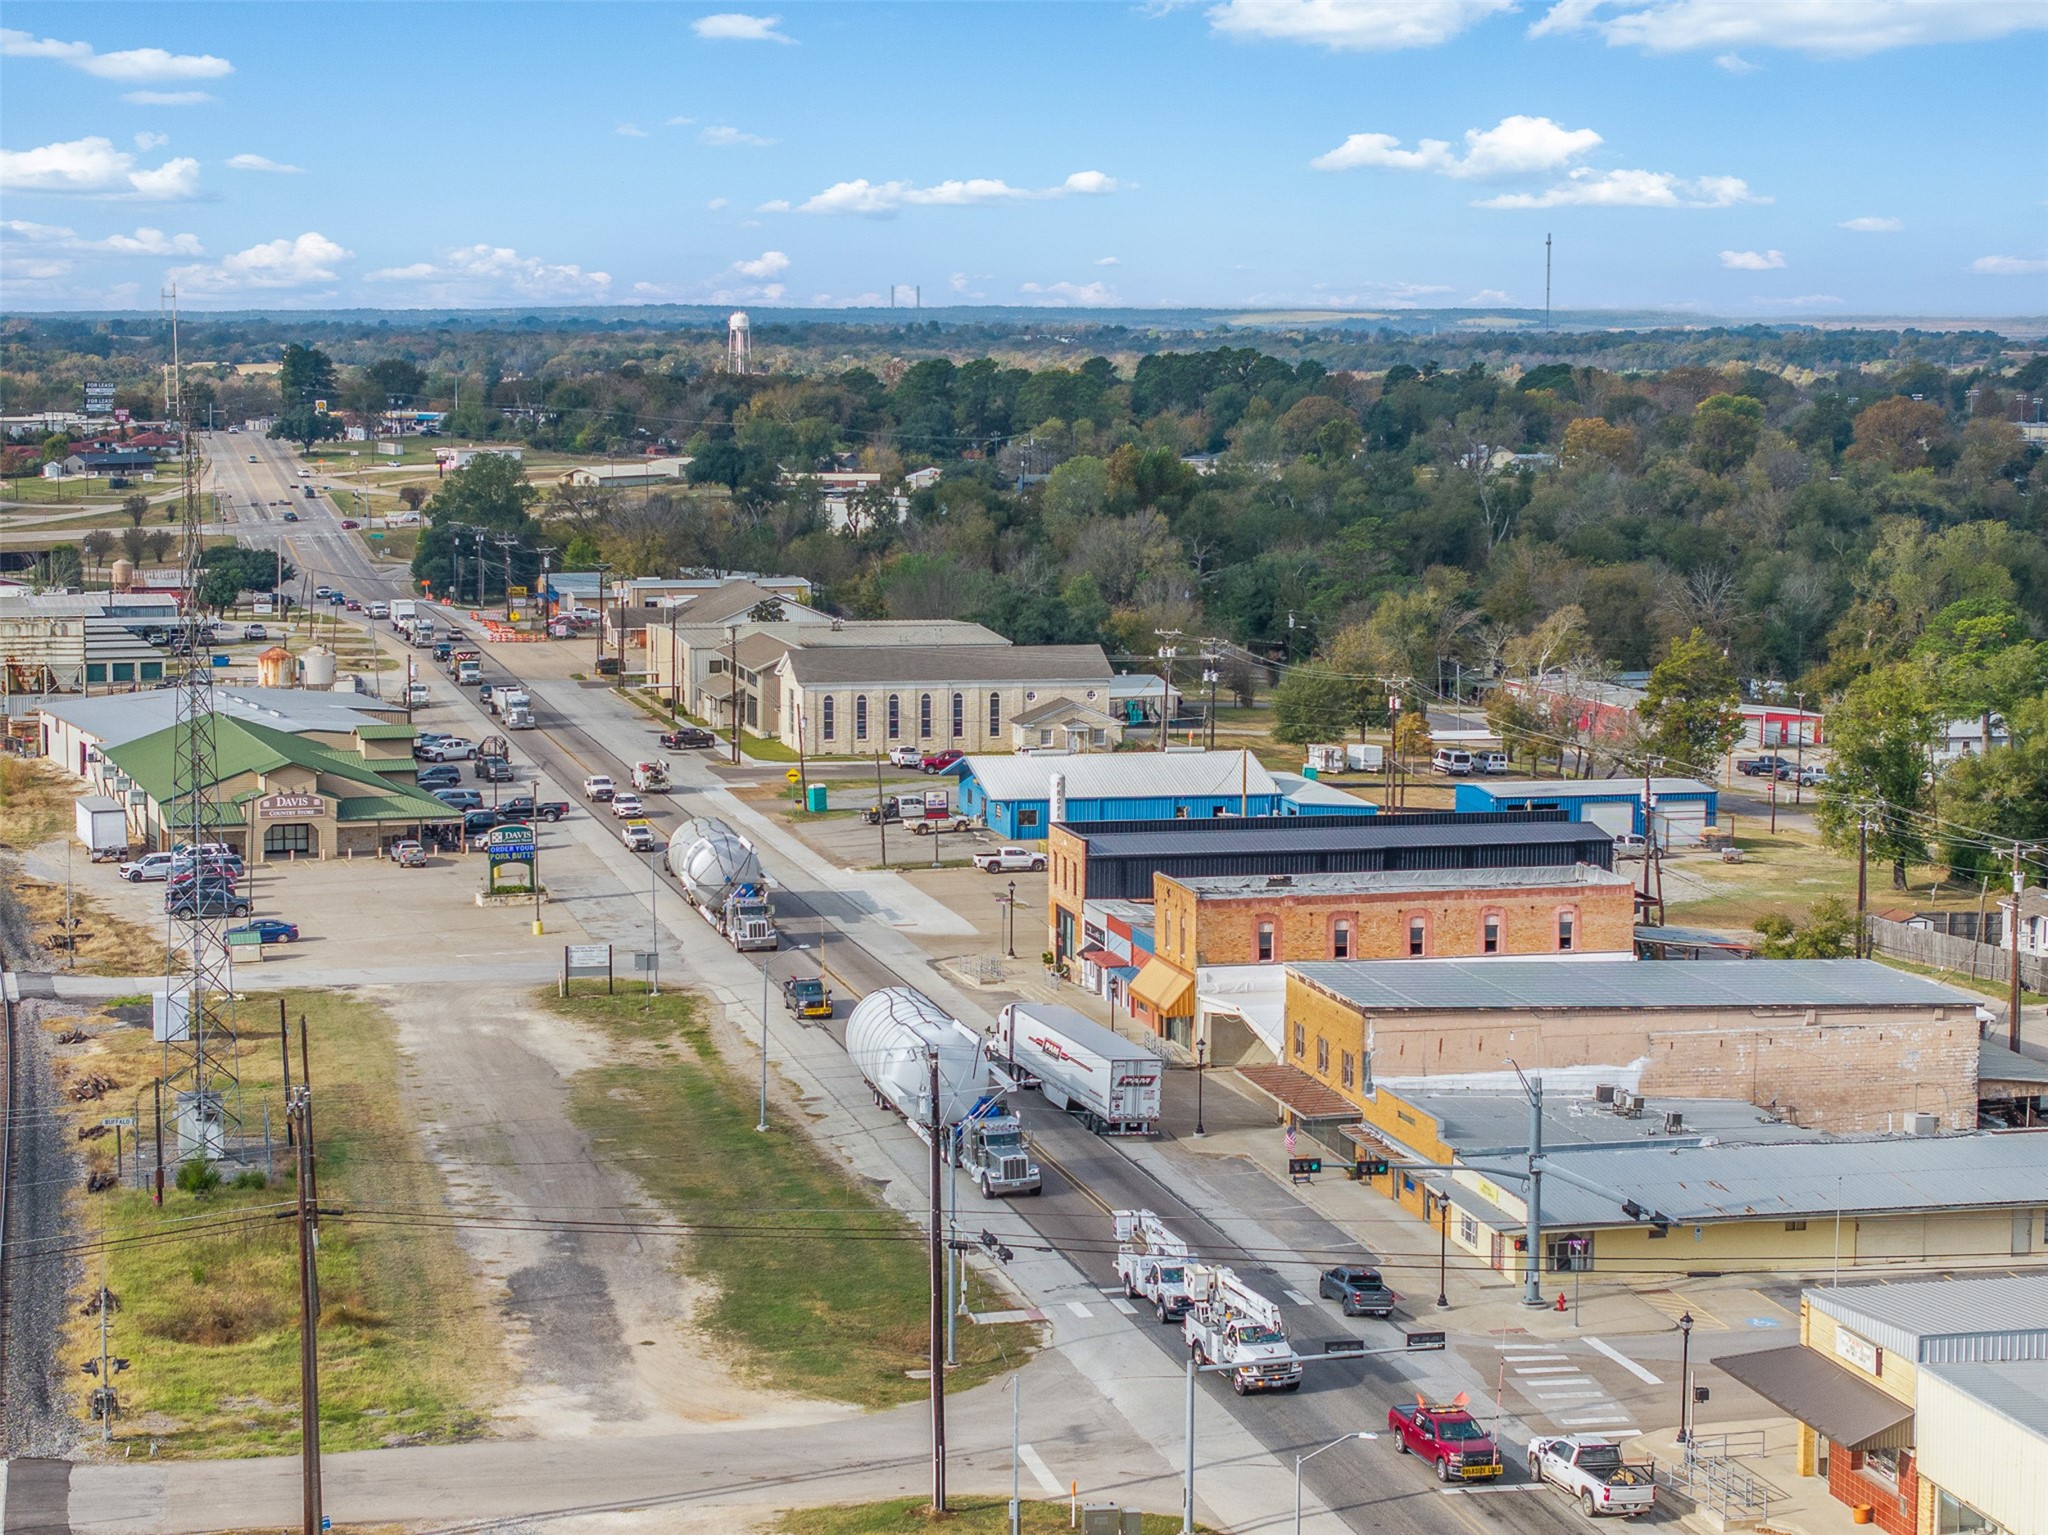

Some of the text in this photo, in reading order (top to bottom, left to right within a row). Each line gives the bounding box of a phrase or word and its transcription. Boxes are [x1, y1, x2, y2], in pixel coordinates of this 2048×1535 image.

[276, 797, 309, 807] DAVIS
[505, 831, 532, 839] DAVIS
[1045, 1041, 1060, 1056] PAM
[1462, 1467, 1487, 1475] OVERSIZE
